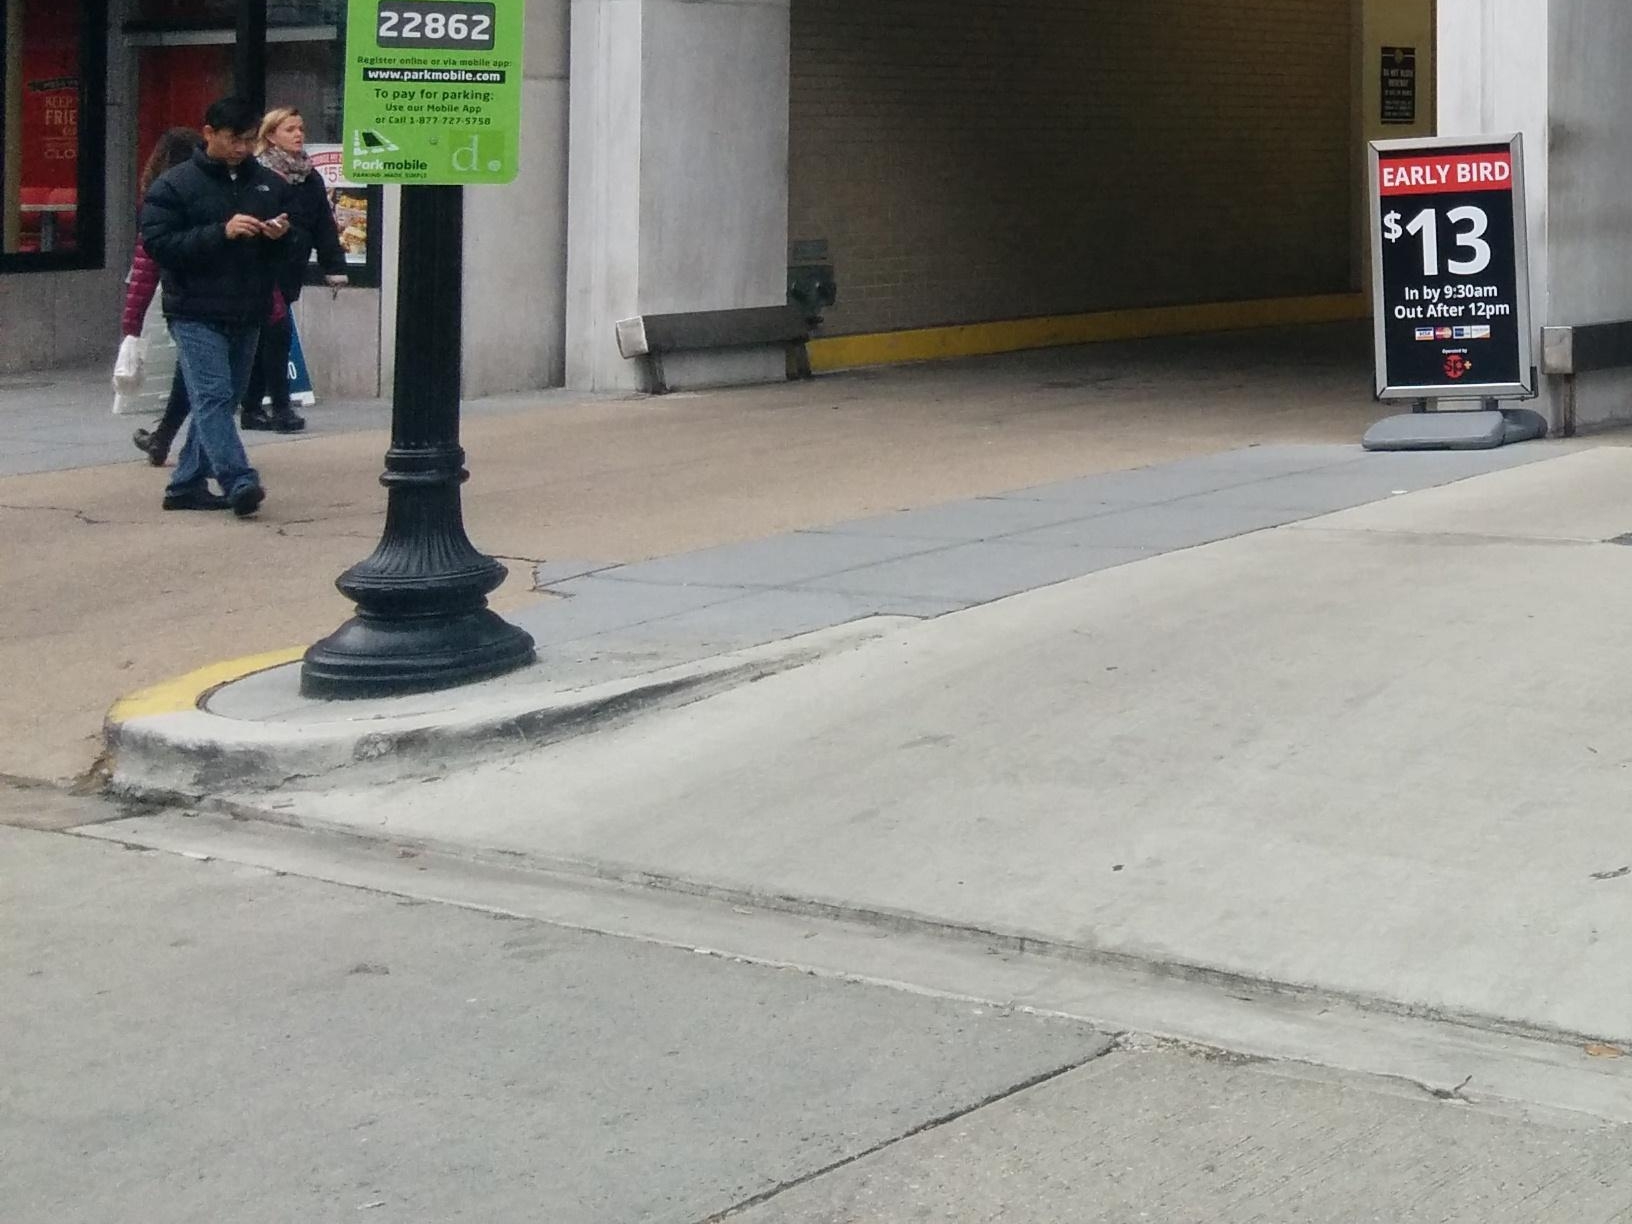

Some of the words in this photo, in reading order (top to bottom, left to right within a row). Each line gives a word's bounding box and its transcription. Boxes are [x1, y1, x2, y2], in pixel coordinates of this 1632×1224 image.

[379, 11, 490, 40] 22862
[357, 56, 397, 65] Register
[400, 57, 428, 65] online
[431, 58, 440, 66] or
[443, 57, 457, 66] via
[459, 57, 490, 66] mobile
[368, 69, 500, 81] www.parkmobile.com
[374, 88, 388, 98] To
[392, 90, 416, 101] pay
[420, 88, 437, 99] for
[442, 89, 494, 102] parking:
[385, 103, 404, 112] Use
[427, 104, 460, 112] Mobile
[462, 104, 482, 114] App
[388, 116, 407, 124] Call
[352, 159, 428, 170] Parkmobile
[1383, 164, 1451, 187] EARLY
[1456, 161, 1510, 183] BIRD
[1383, 205, 1491, 276] $13
[1405, 286, 1419, 301] In
[1423, 285, 1440, 303] by
[1443, 284, 1498, 299] 9:30am
[1394, 305, 1423, 319] Out
[1426, 302, 1465, 318] After
[1468, 302, 1510, 320] 12pm
